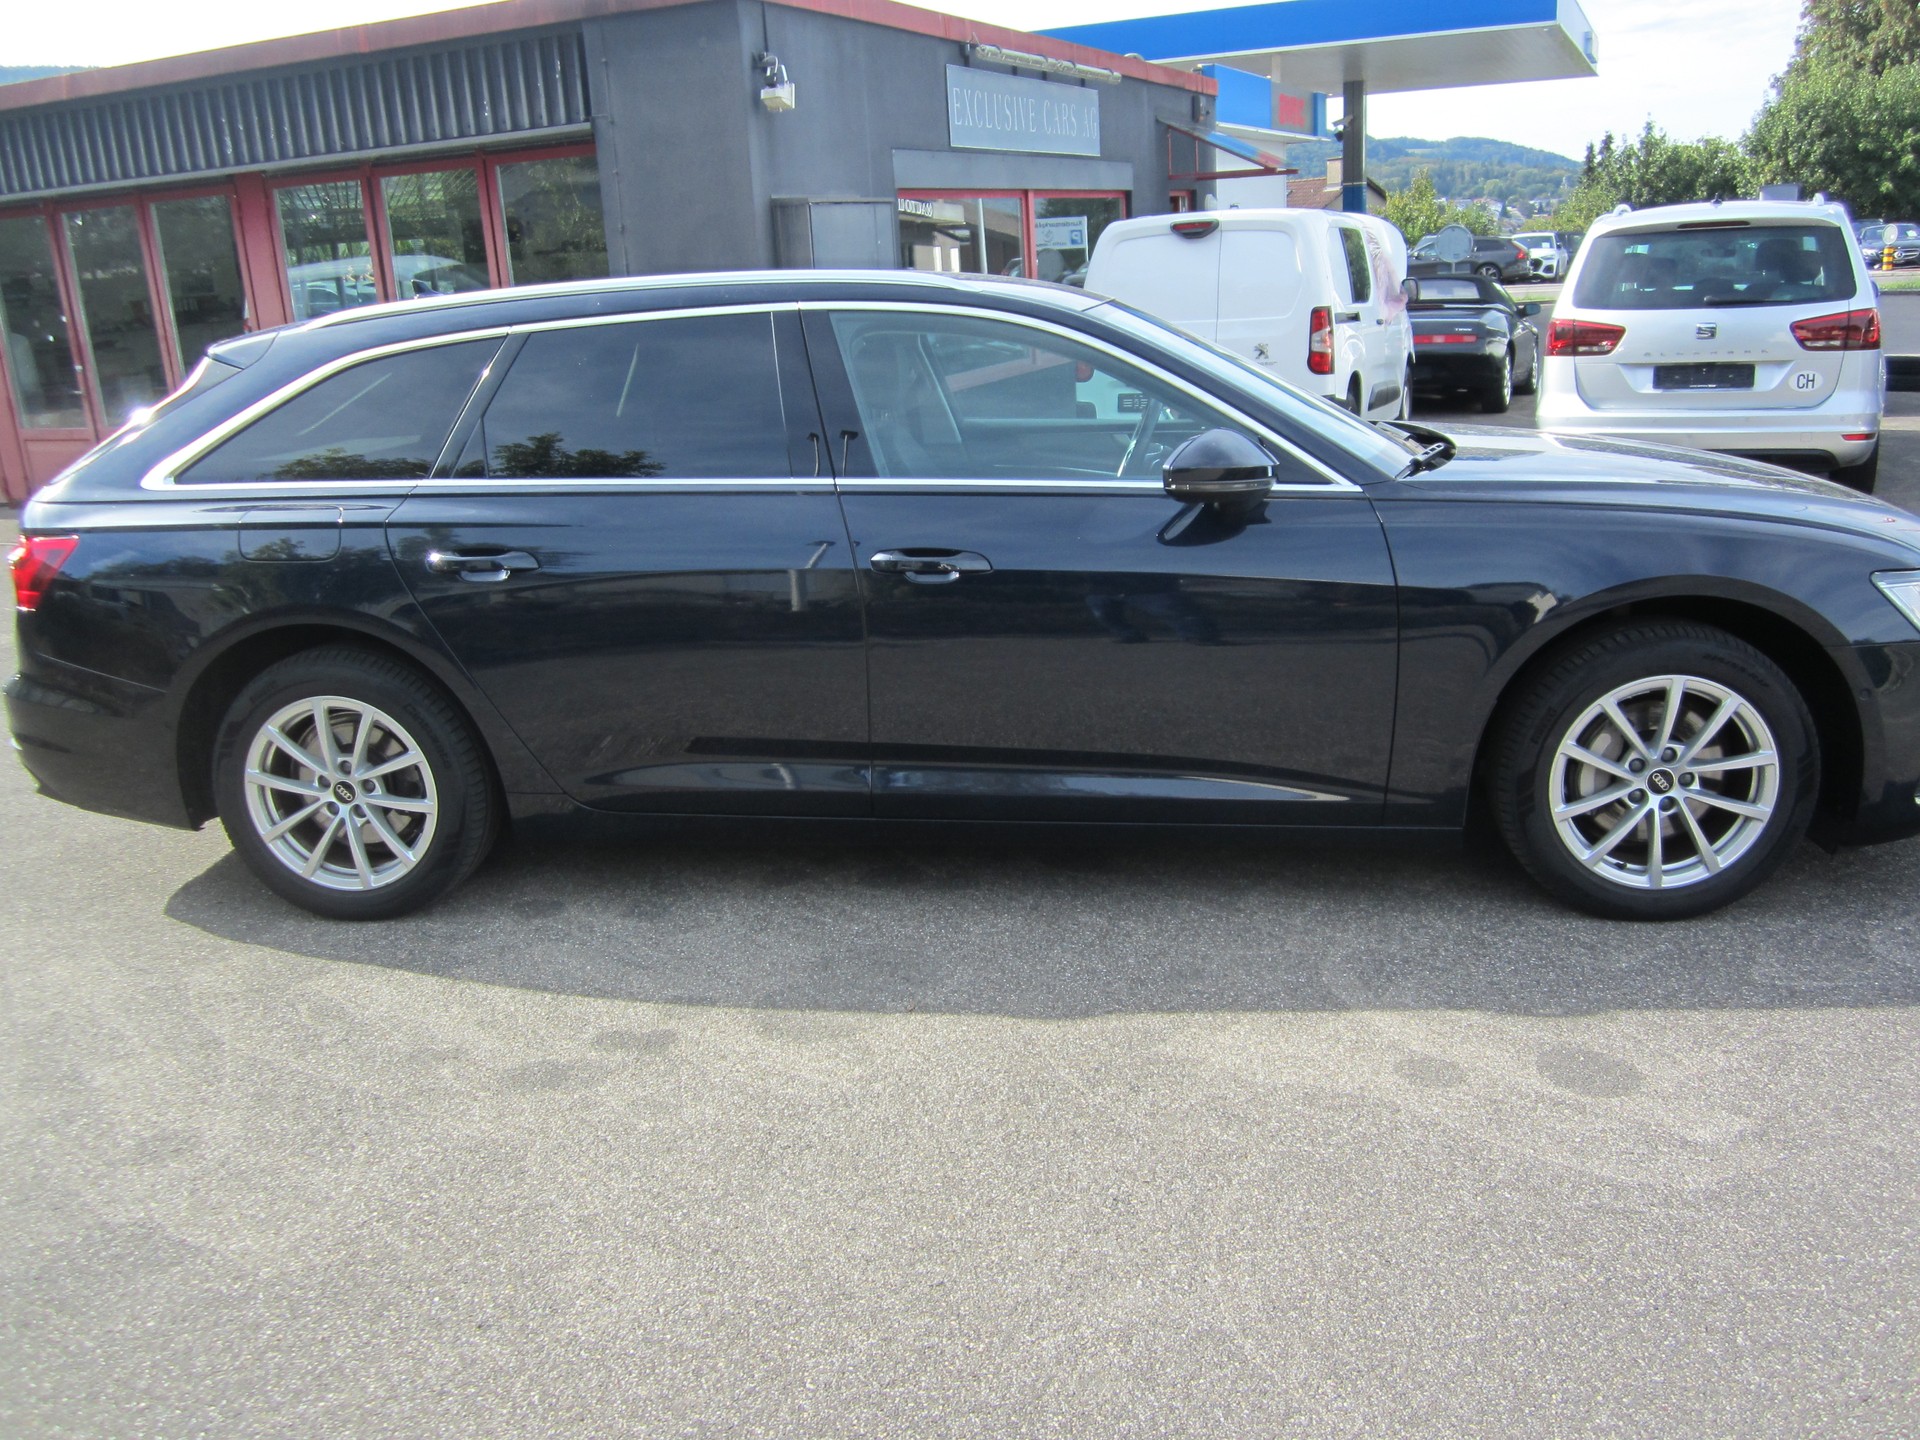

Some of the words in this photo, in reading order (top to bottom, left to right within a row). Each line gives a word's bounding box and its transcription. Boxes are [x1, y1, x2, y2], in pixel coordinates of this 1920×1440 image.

[953, 87, 1037, 133] EXCLUSIVE
[1043, 99, 1077, 137] CARS
[1083, 106, 1098, 140] AG
[1796, 373, 1816, 389] CH
